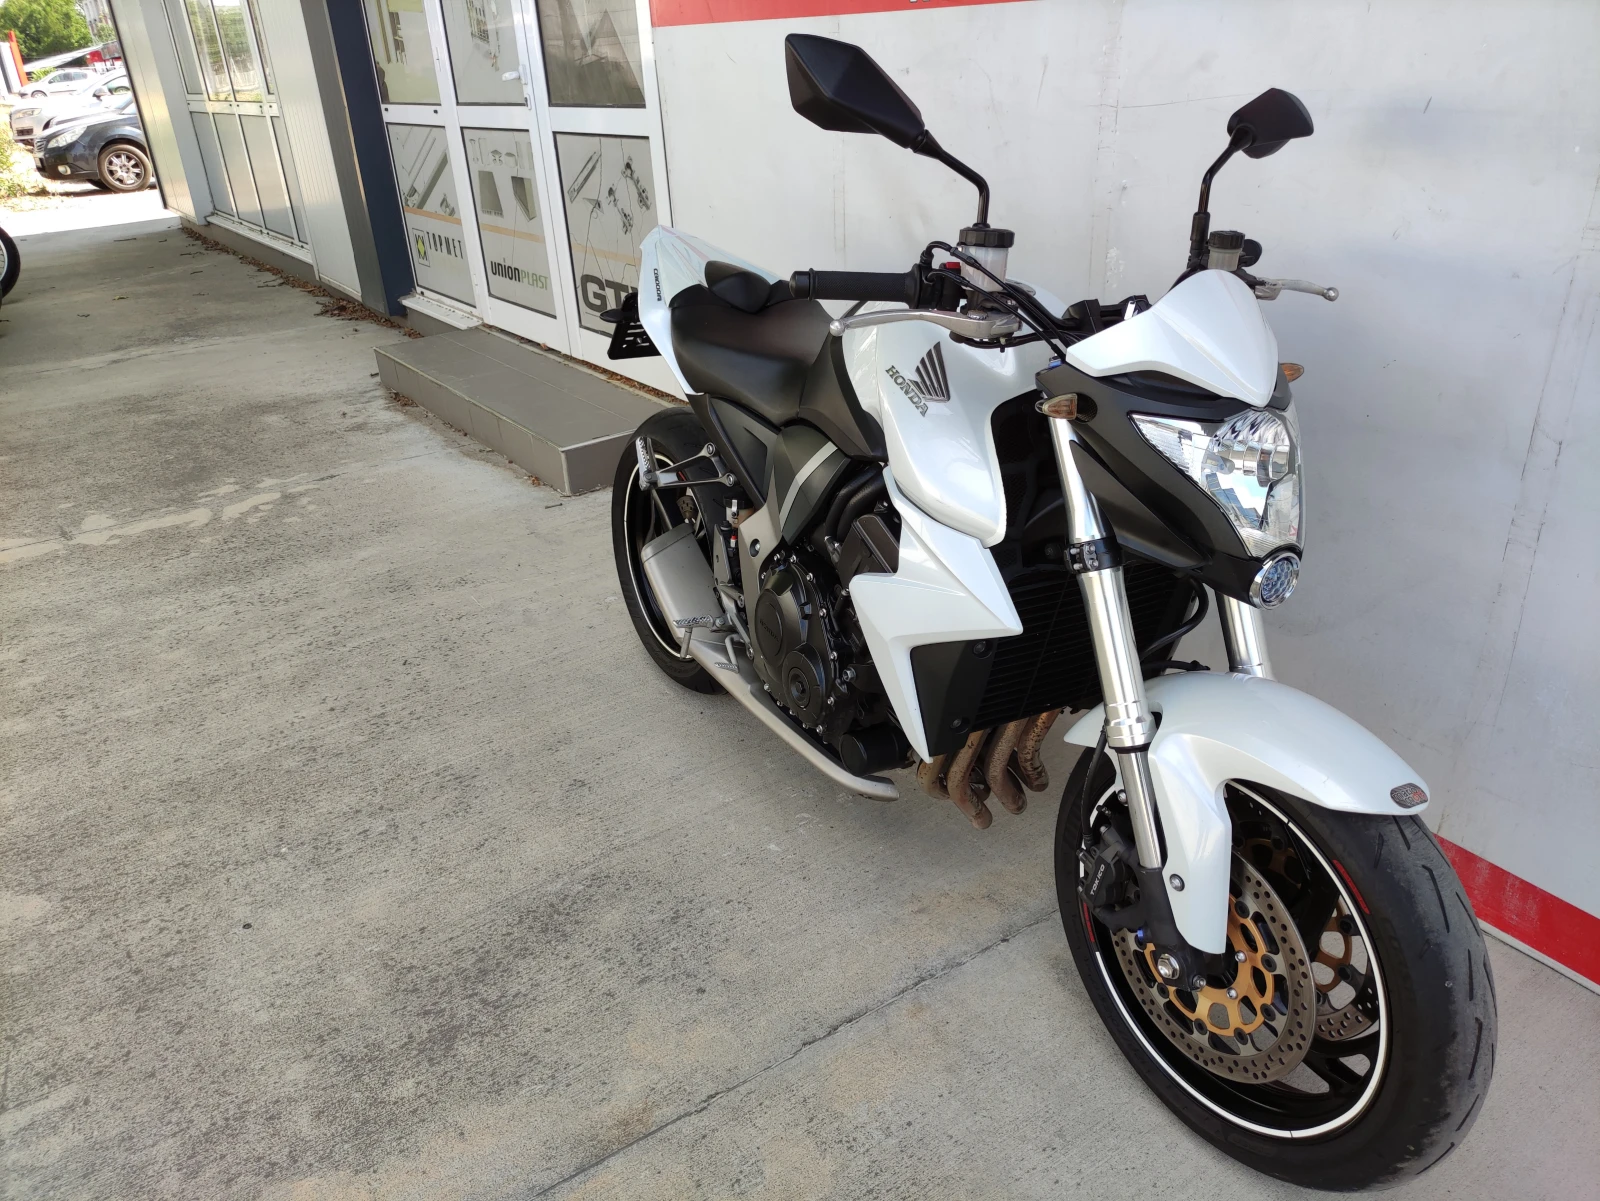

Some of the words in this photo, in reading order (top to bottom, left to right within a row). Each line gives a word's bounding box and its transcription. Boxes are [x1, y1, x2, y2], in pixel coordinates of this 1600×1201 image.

[426, 231, 464, 260] TOPMET
[580, 274, 638, 312] GT
[885, 365, 929, 418] HONDA
[1090, 863, 1105, 896] TOKICO
